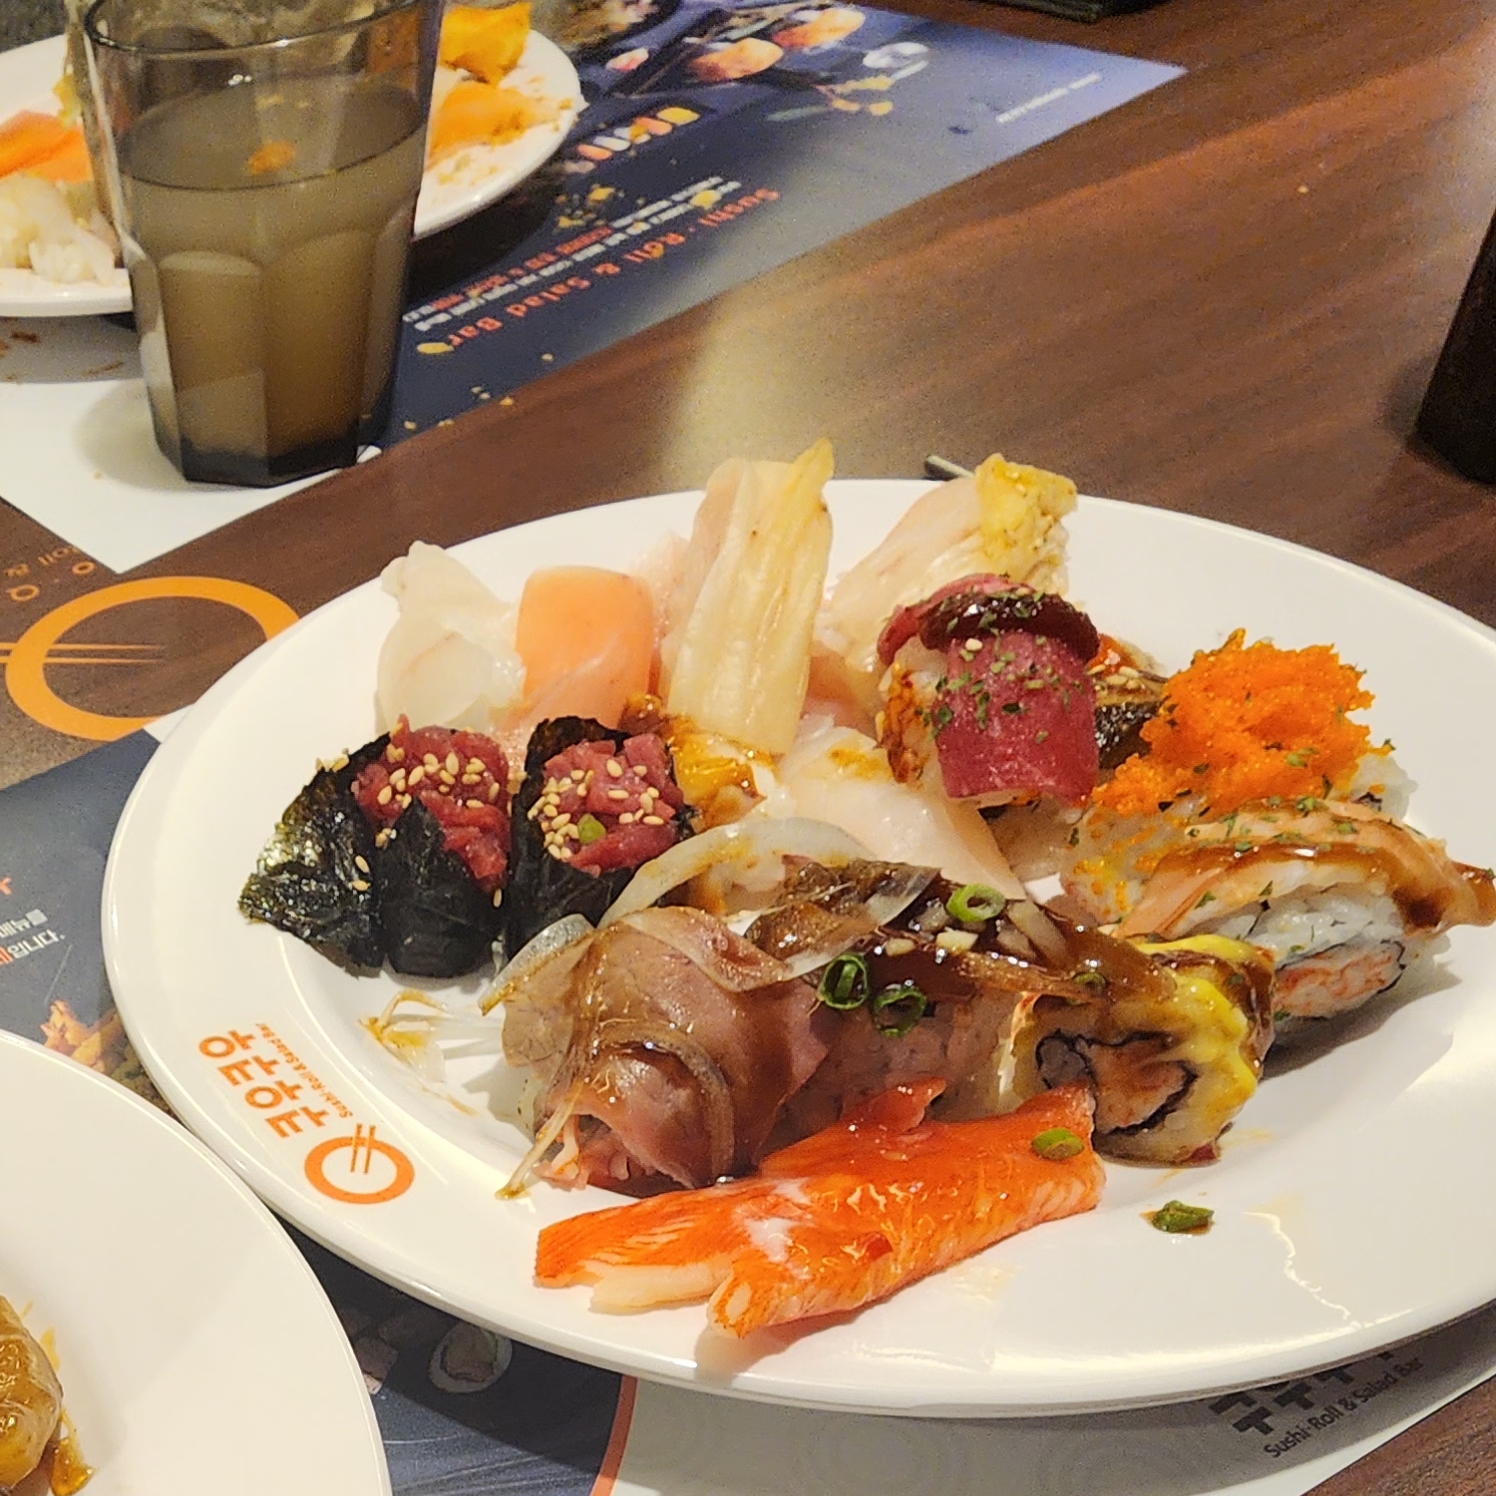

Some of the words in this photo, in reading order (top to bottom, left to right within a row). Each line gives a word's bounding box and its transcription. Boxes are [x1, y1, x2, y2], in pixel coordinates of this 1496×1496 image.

[506, 276, 591, 317] Salad
[448, 316, 503, 347] Bar
[1351, 1372, 1398, 1403] Salad
